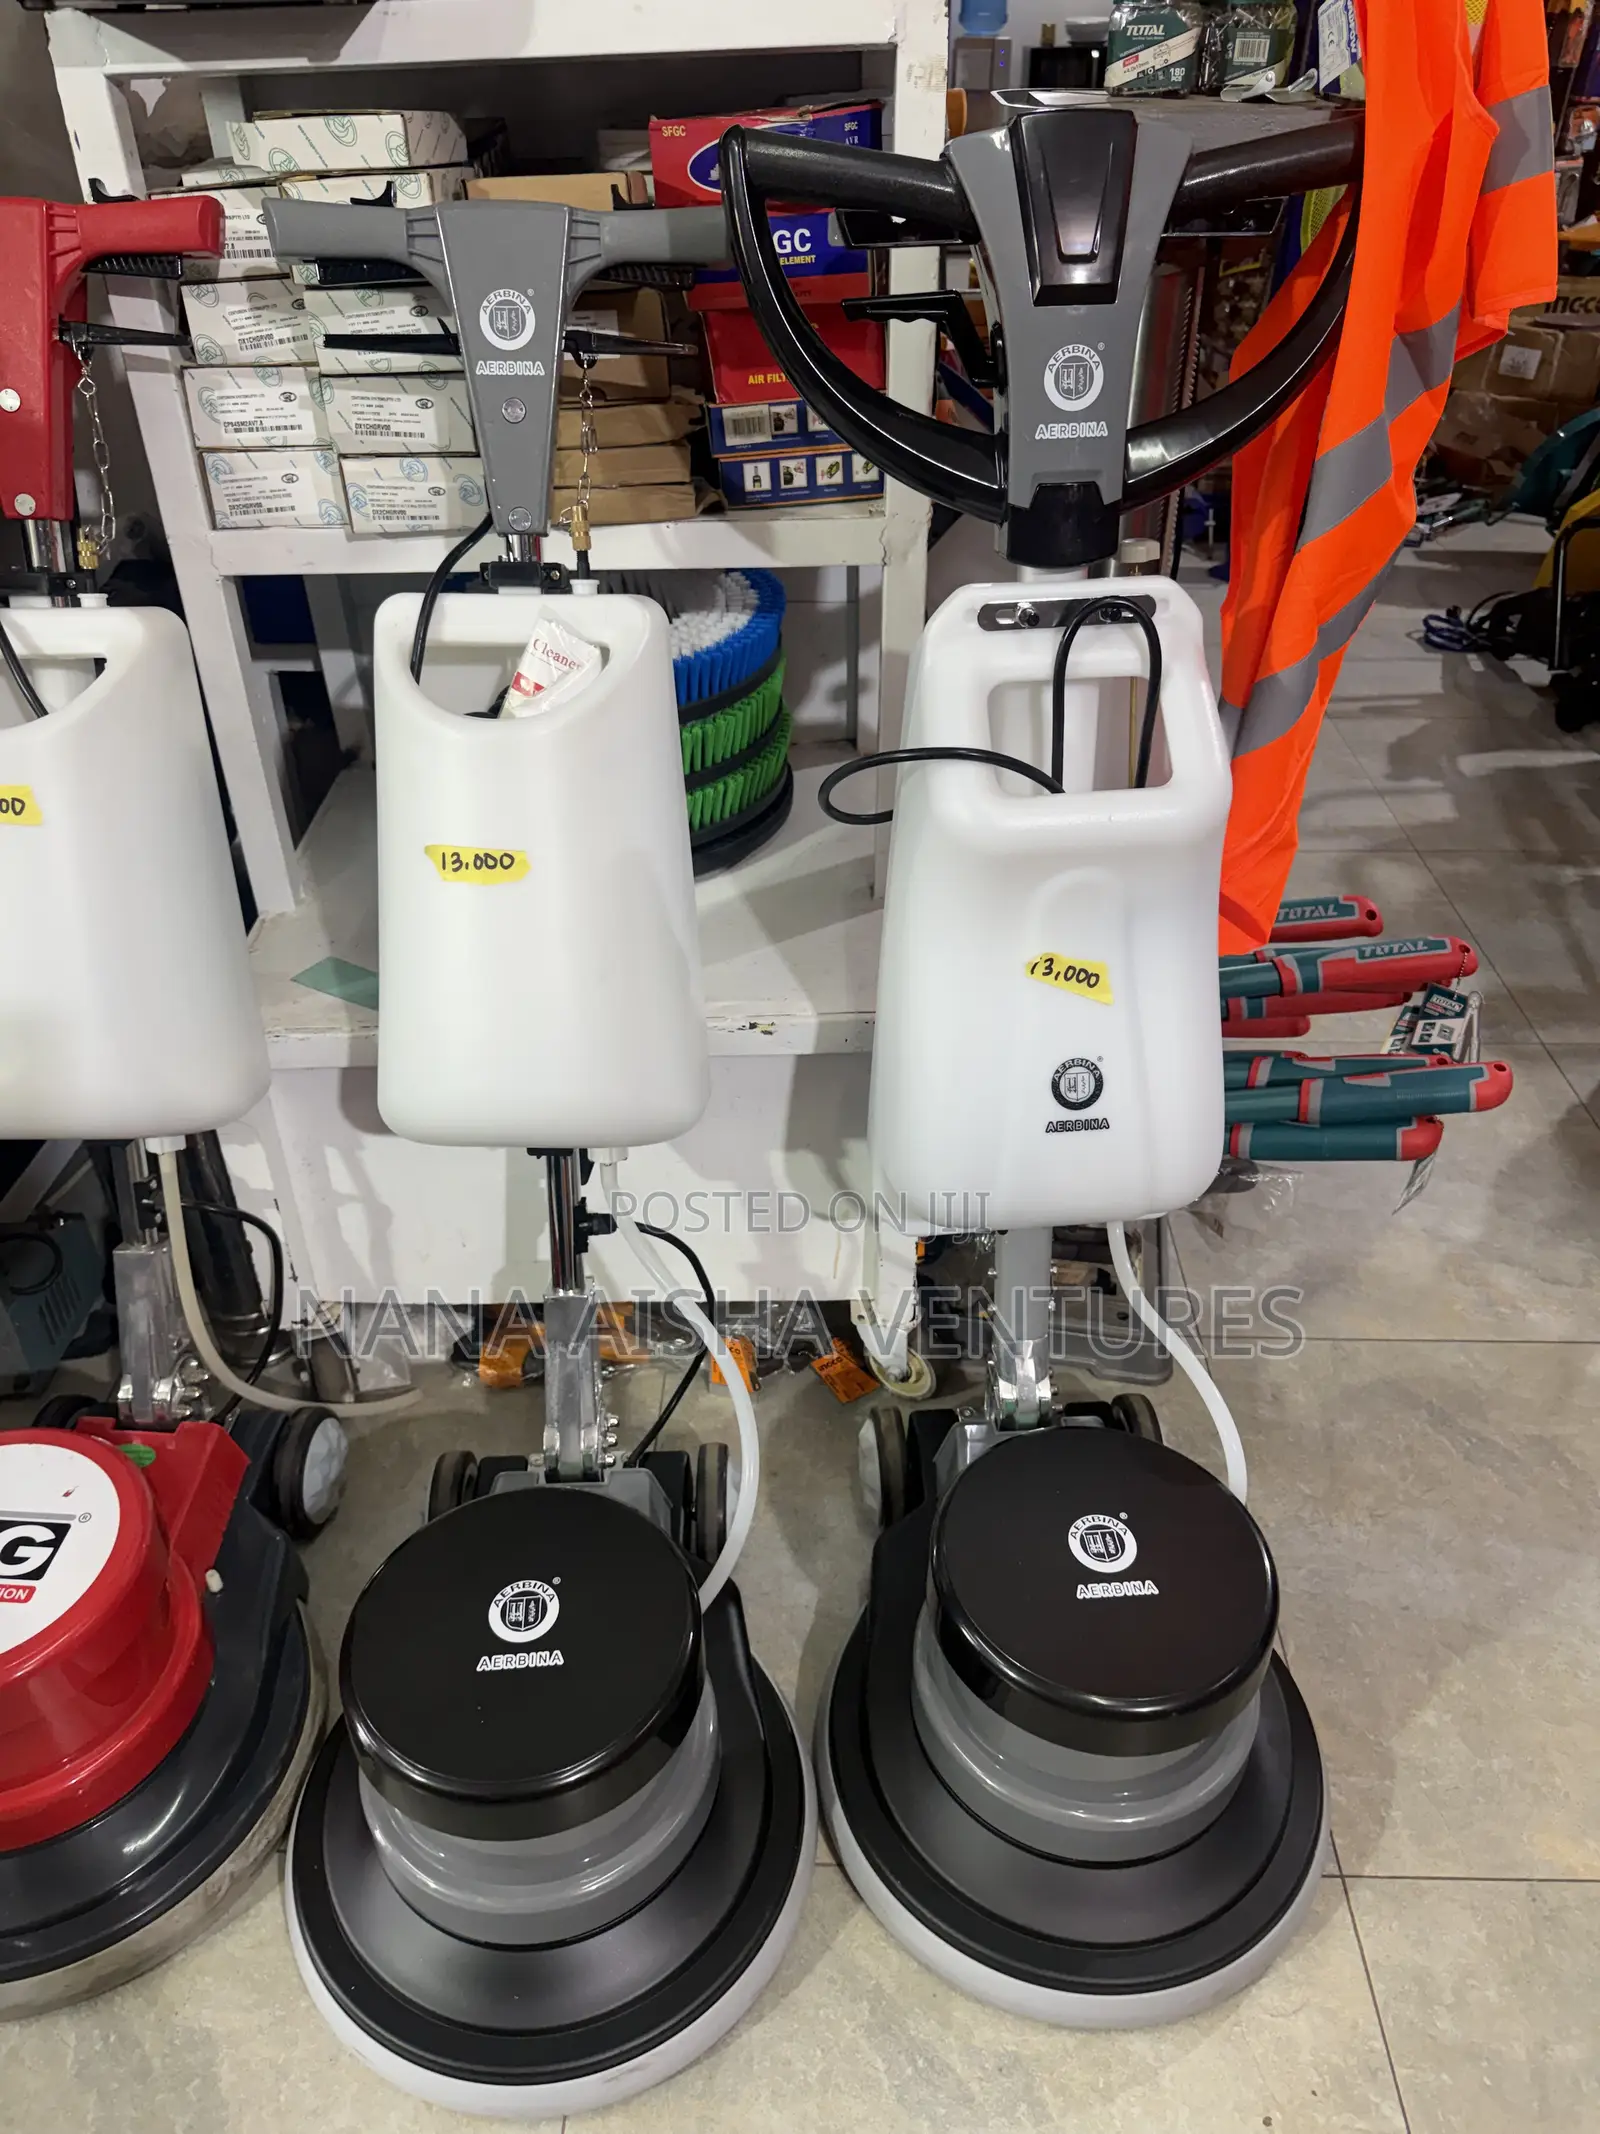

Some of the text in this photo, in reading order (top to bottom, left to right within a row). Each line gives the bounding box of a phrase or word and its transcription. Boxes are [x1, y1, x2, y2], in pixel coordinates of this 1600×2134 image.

[1126, 24, 1166, 37] TOTAL
[1169, 67, 1186, 76] 180
[661, 125, 687, 137] SFGC
[773, 228, 812, 254] GC
[780, 254, 816, 266] ELEMENT
[481, 289, 533, 316] AERBINA
[476, 360, 545, 376] AERBINA
[1047, 345, 1101, 374] AERBINA
[748, 373, 788, 385] AIR FILT
[1034, 420, 1109, 440] AERBINA
[532, 637, 584, 671] Cleaner
[1277, 903, 1339, 921] TOTAL
[1362, 940, 1429, 958] TOTAL
[1030, 955, 1100, 989] 13,000
[1053, 1057, 1101, 1082] AERBINA
[1045, 1118, 1110, 1134] AERBINA
[1070, 1515, 1128, 1541] AERBINA
[0, 1524, 56, 1577] G
[0, 1588, 30, 1601] ION
[493, 1581, 556, 1608] AERBINA
[1076, 1579, 1160, 1600] AERBINA
[475, 1649, 565, 1672] AERBINA
